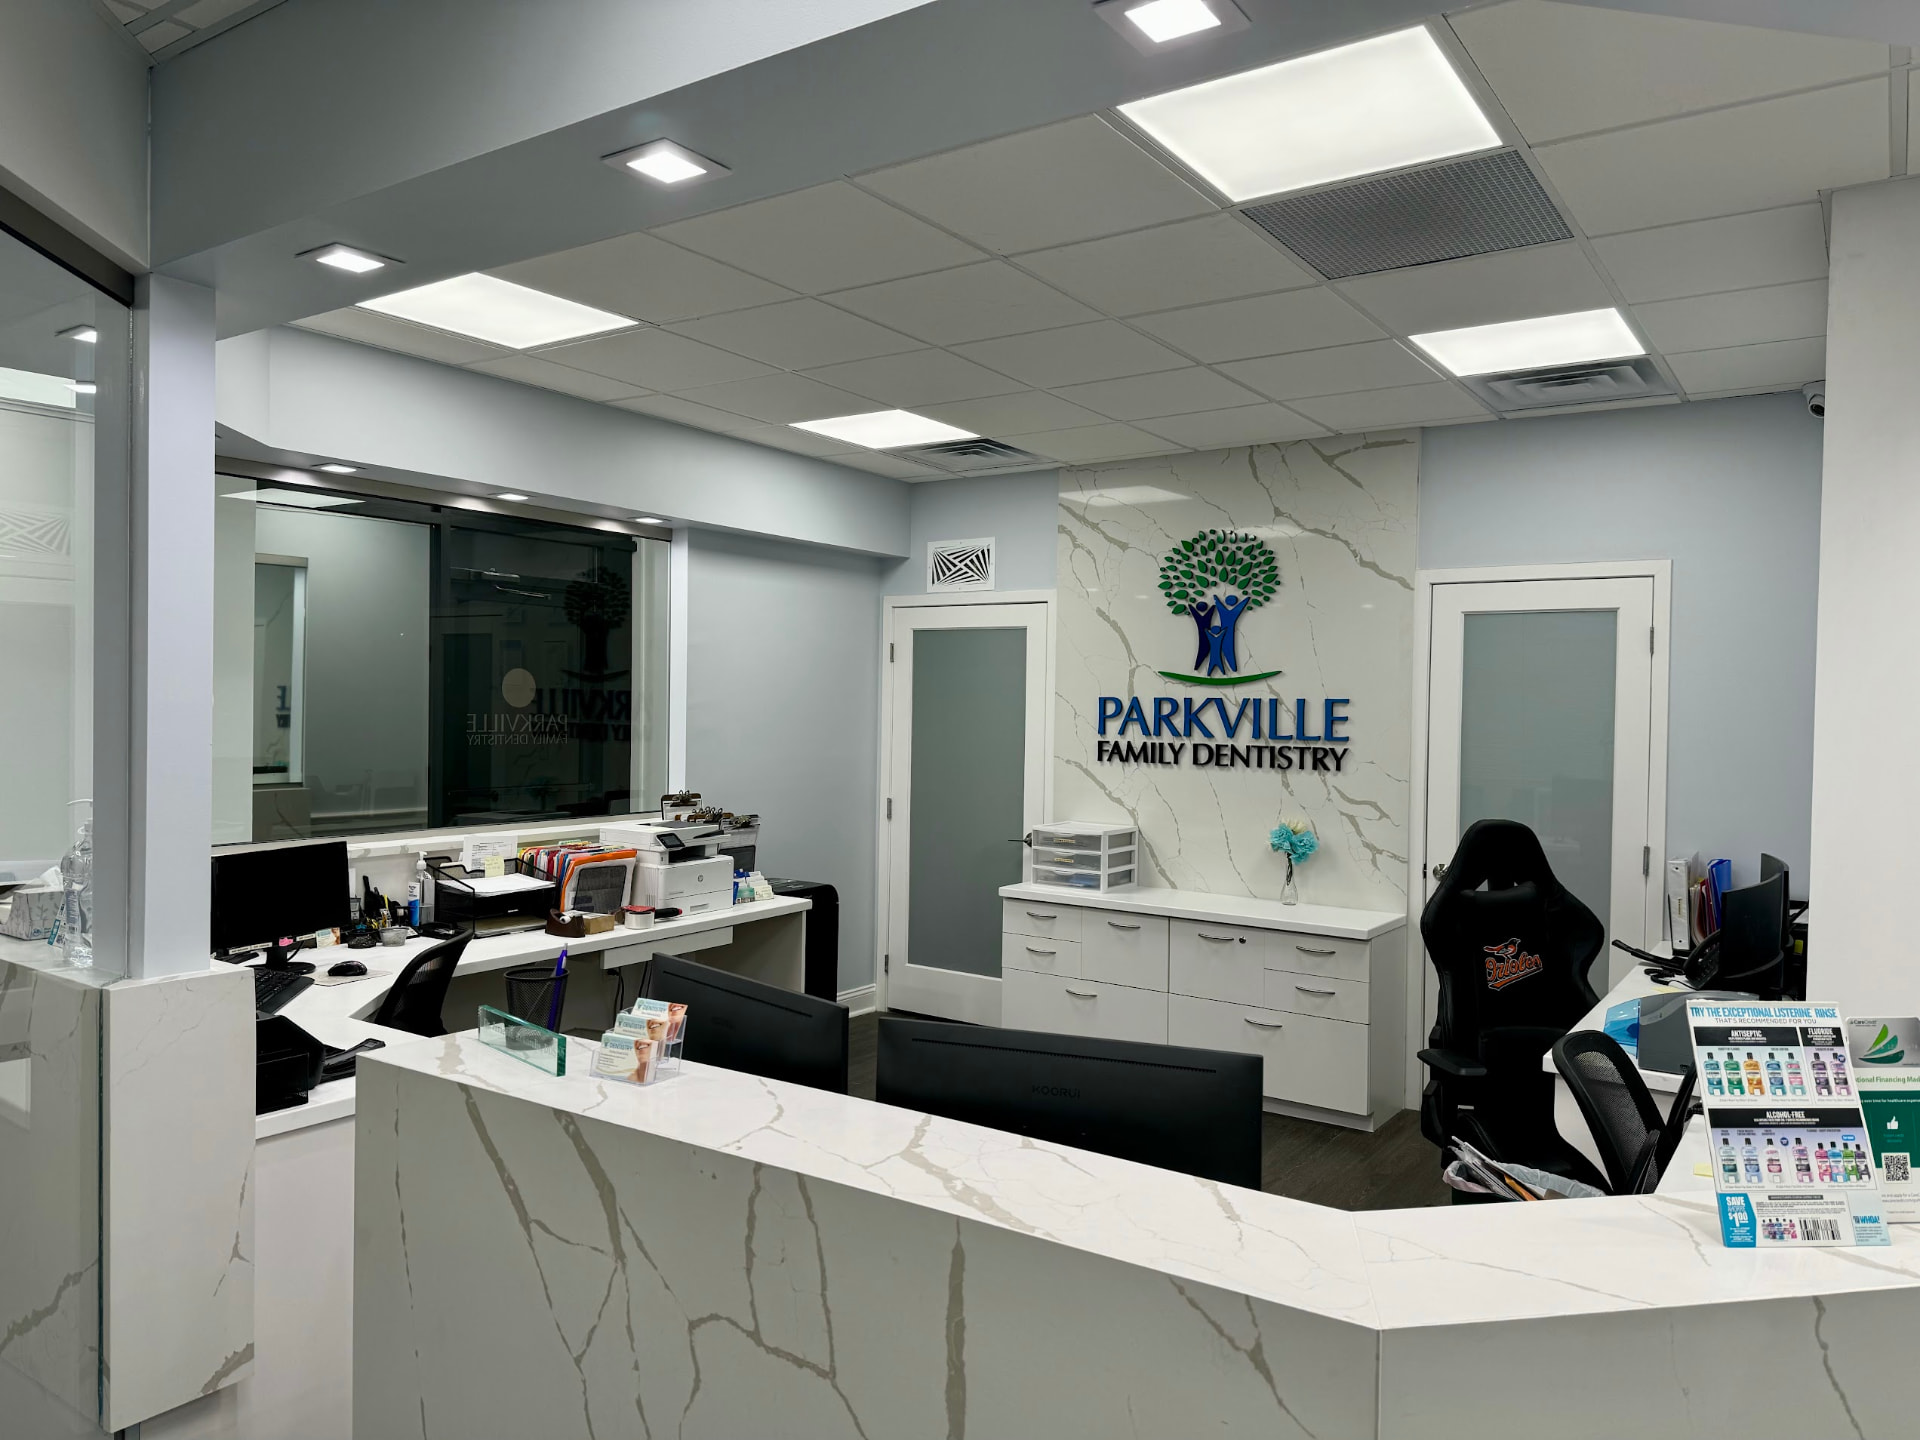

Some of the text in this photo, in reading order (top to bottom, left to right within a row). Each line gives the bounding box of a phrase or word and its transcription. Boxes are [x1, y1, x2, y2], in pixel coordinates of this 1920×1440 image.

[1097, 696, 1350, 742] PARKVILLE
[1097, 740, 1349, 771] FAMILY DENTISTRY
[1485, 951, 1543, 982] Orioles
[1690, 1007, 1837, 1018] TRY THE EXCEPTIONAL LISTERINE RINSE
[1876, 1076, 1906, 1084] Financing
[1726, 1196, 1745, 1206] SAVE
